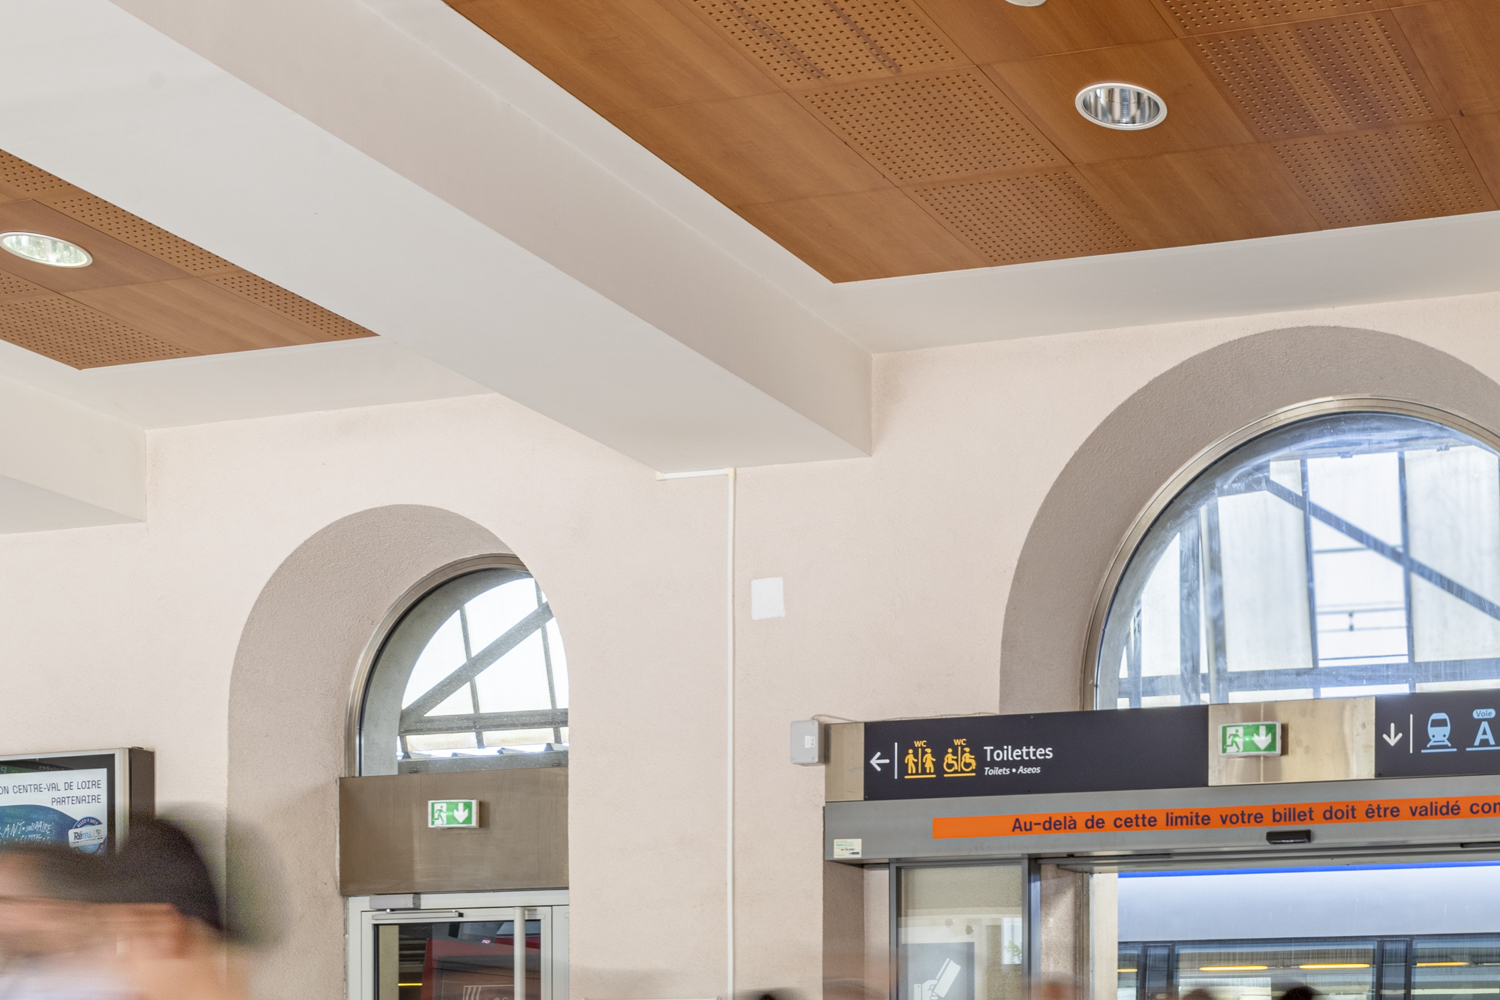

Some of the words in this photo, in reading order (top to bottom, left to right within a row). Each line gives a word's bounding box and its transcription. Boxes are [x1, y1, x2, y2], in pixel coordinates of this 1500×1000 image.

[1475, 709, 1493, 717] Voie
[1473, 721, 1496, 746] A
[914, 740, 927, 748] WC
[953, 738, 967, 746] WC
[983, 746, 1054, 761] Toilettes
[984, 766, 1010, 775] Toilets
[1017, 765, 1041, 775] Aseos
[12, 782, 61, 795] CENTRE-VAL
[63, 781, 74, 791] DE
[76, 779, 102, 790] LOIRE
[51, 794, 102, 806] PARTENAIRE
[1012, 815, 1077, 832] Au-delà
[1085, 815, 1105, 829] de
[1113, 813, 1157, 828] cette
[1165, 811, 1211, 827] limite
[1220, 810, 1263, 825] votre
[1272, 807, 1314, 823] billet
[1323, 805, 1357, 820] doit
[1365, 803, 1400, 818] être
[1409, 800, 1461, 817] validé
